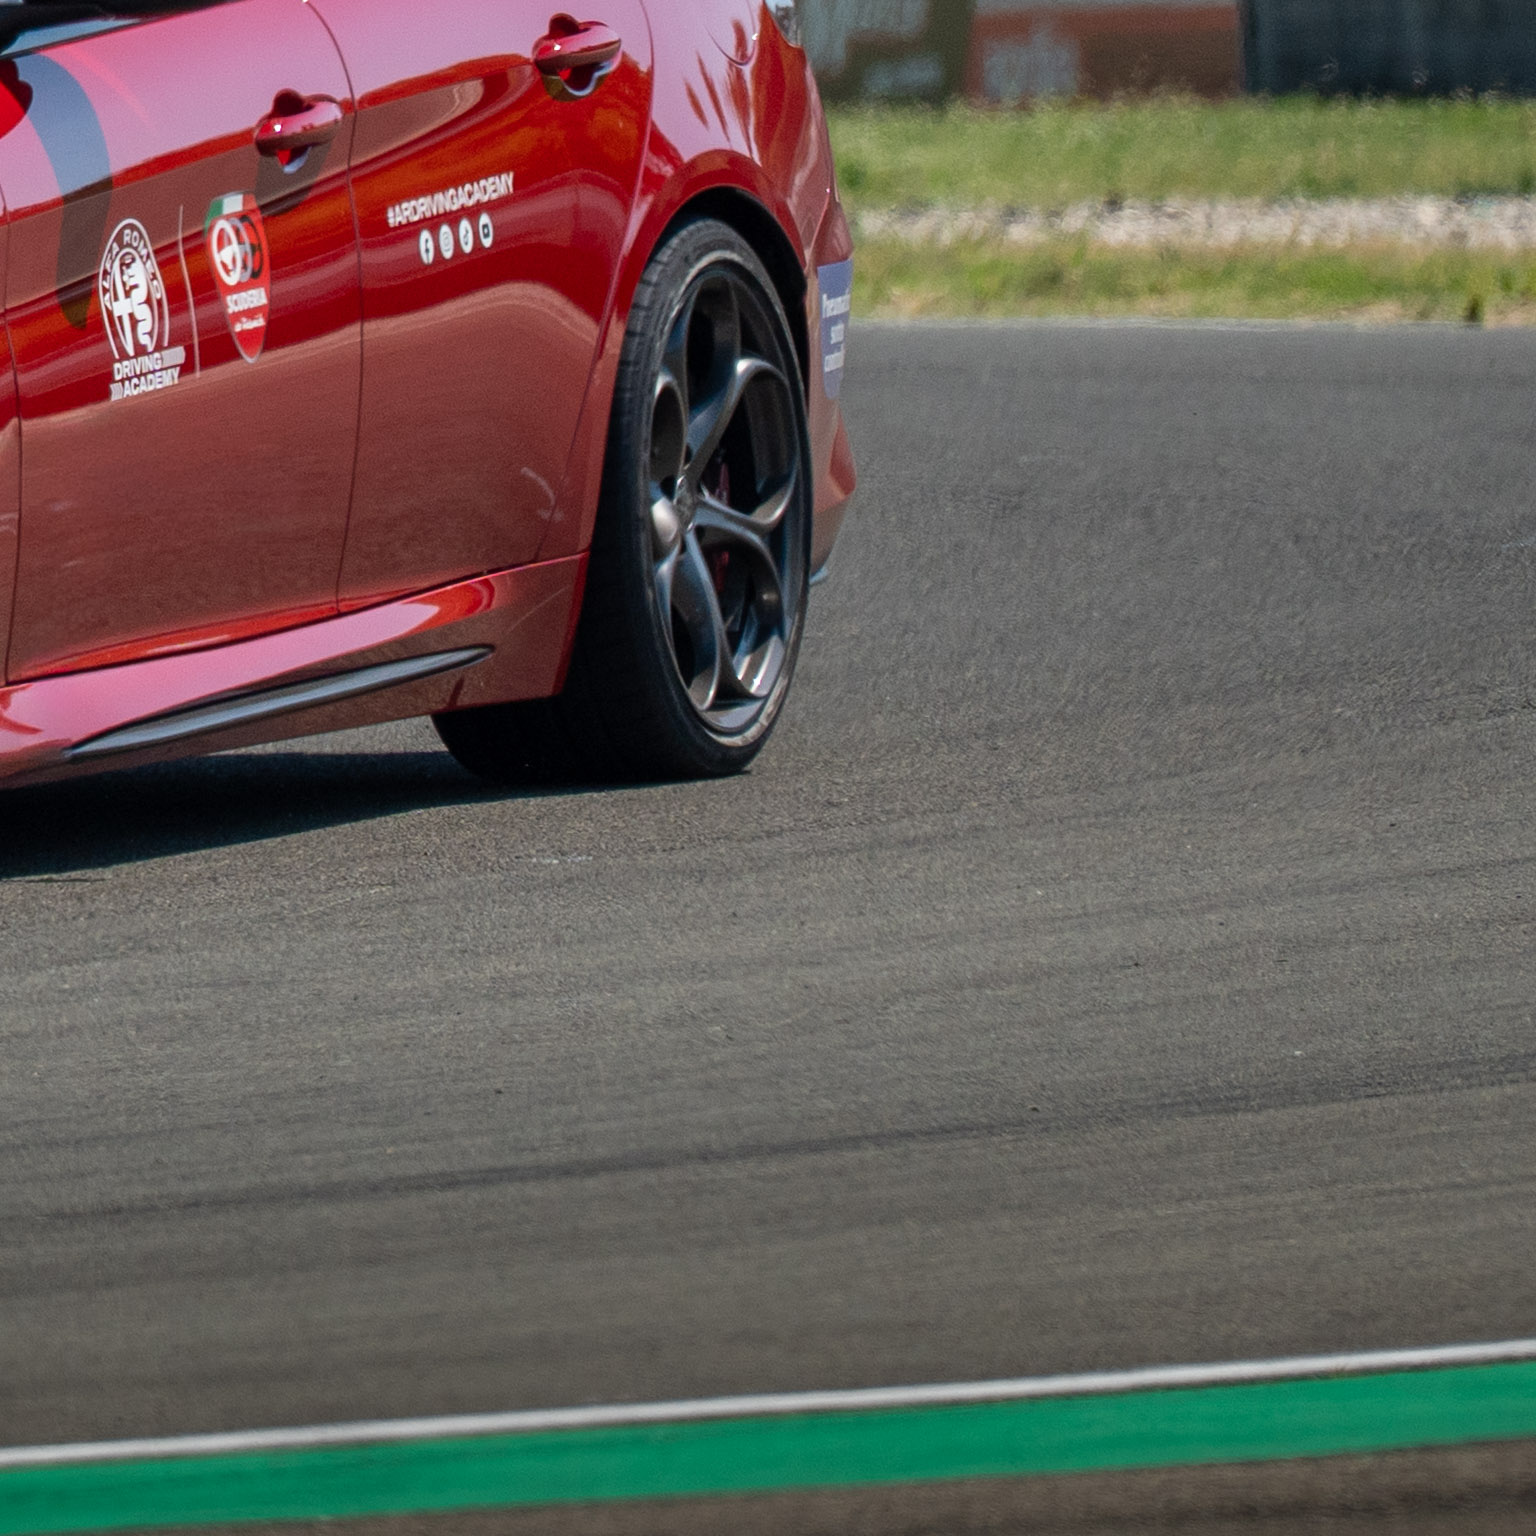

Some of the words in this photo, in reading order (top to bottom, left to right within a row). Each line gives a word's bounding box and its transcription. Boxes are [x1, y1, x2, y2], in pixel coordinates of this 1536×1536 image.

[386, 170, 515, 228] #ARDRIVINGACADEMY
[122, 228, 162, 300] ROMEO
[113, 351, 163, 381] DRIVING
[123, 366, 181, 398] ACADEMY
